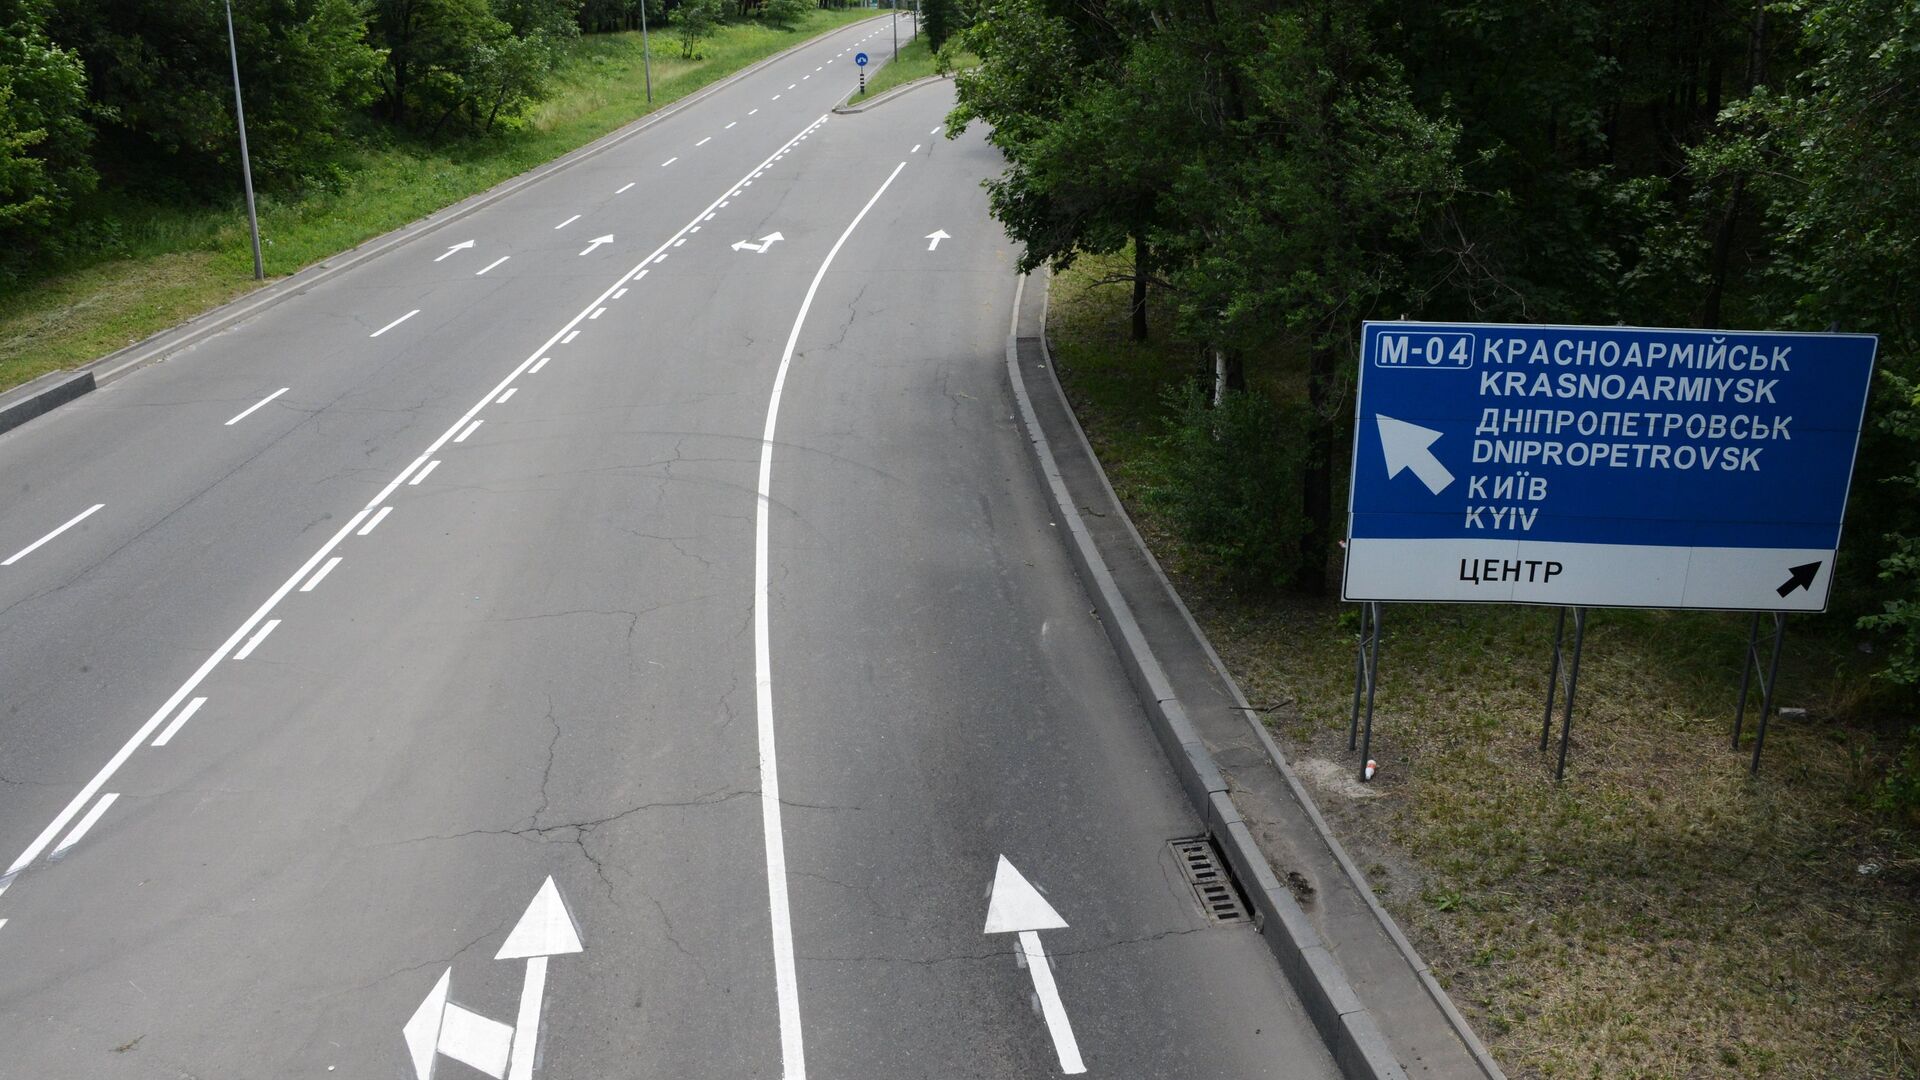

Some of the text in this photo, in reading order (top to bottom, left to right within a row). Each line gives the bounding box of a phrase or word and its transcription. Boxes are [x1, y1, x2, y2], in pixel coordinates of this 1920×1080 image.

[1483, 336, 1792, 371] КРАСНОАРМІЙСЬК
[1479, 371, 1779, 404] KRASNOARMIYSK
[1475, 408, 1792, 441] ДНІПРОПЕТРОВСЬК
[1472, 439, 1763, 472] DNIPROPETROVSK
[1468, 470, 1548, 501] КИЇВ
[1465, 506, 1539, 531] KYIV
[1459, 558, 1563, 586] ЦЕНТР
